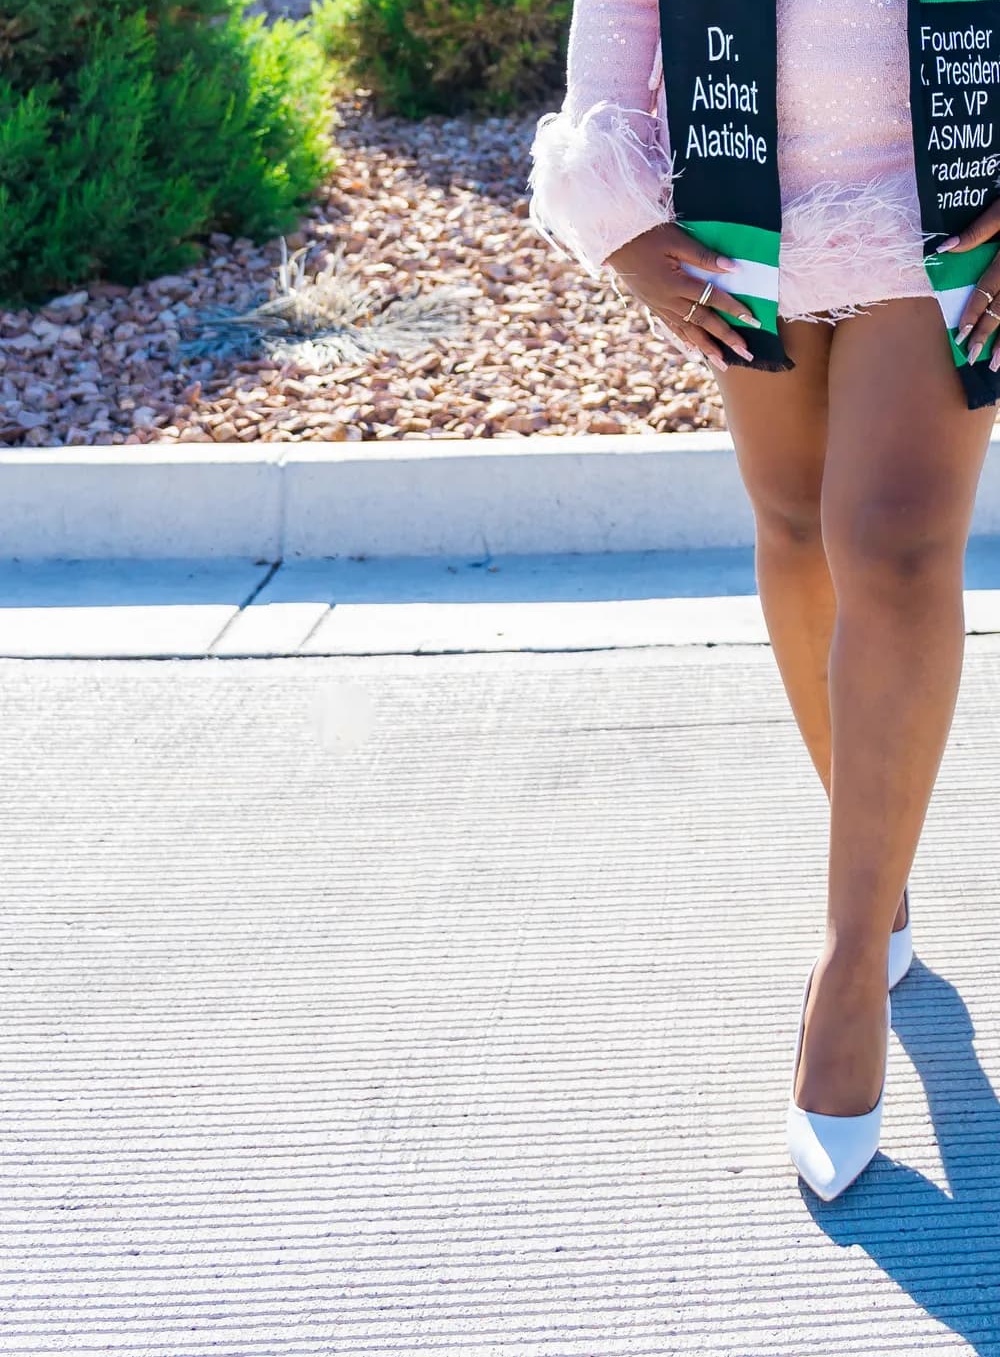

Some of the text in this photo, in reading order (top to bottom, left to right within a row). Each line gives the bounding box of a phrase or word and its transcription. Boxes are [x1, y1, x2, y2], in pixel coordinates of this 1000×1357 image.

[707, 26, 739, 62] Dr.
[920, 24, 993, 52] Founder
[692, 73, 759, 115] Aishat
[932, 90, 988, 117] Ex VP
[685, 121, 768, 164] Alatishe
[927, 122, 993, 151] ASNMU
[931, 156, 997, 182] raduate
[936, 185, 989, 210] enator
